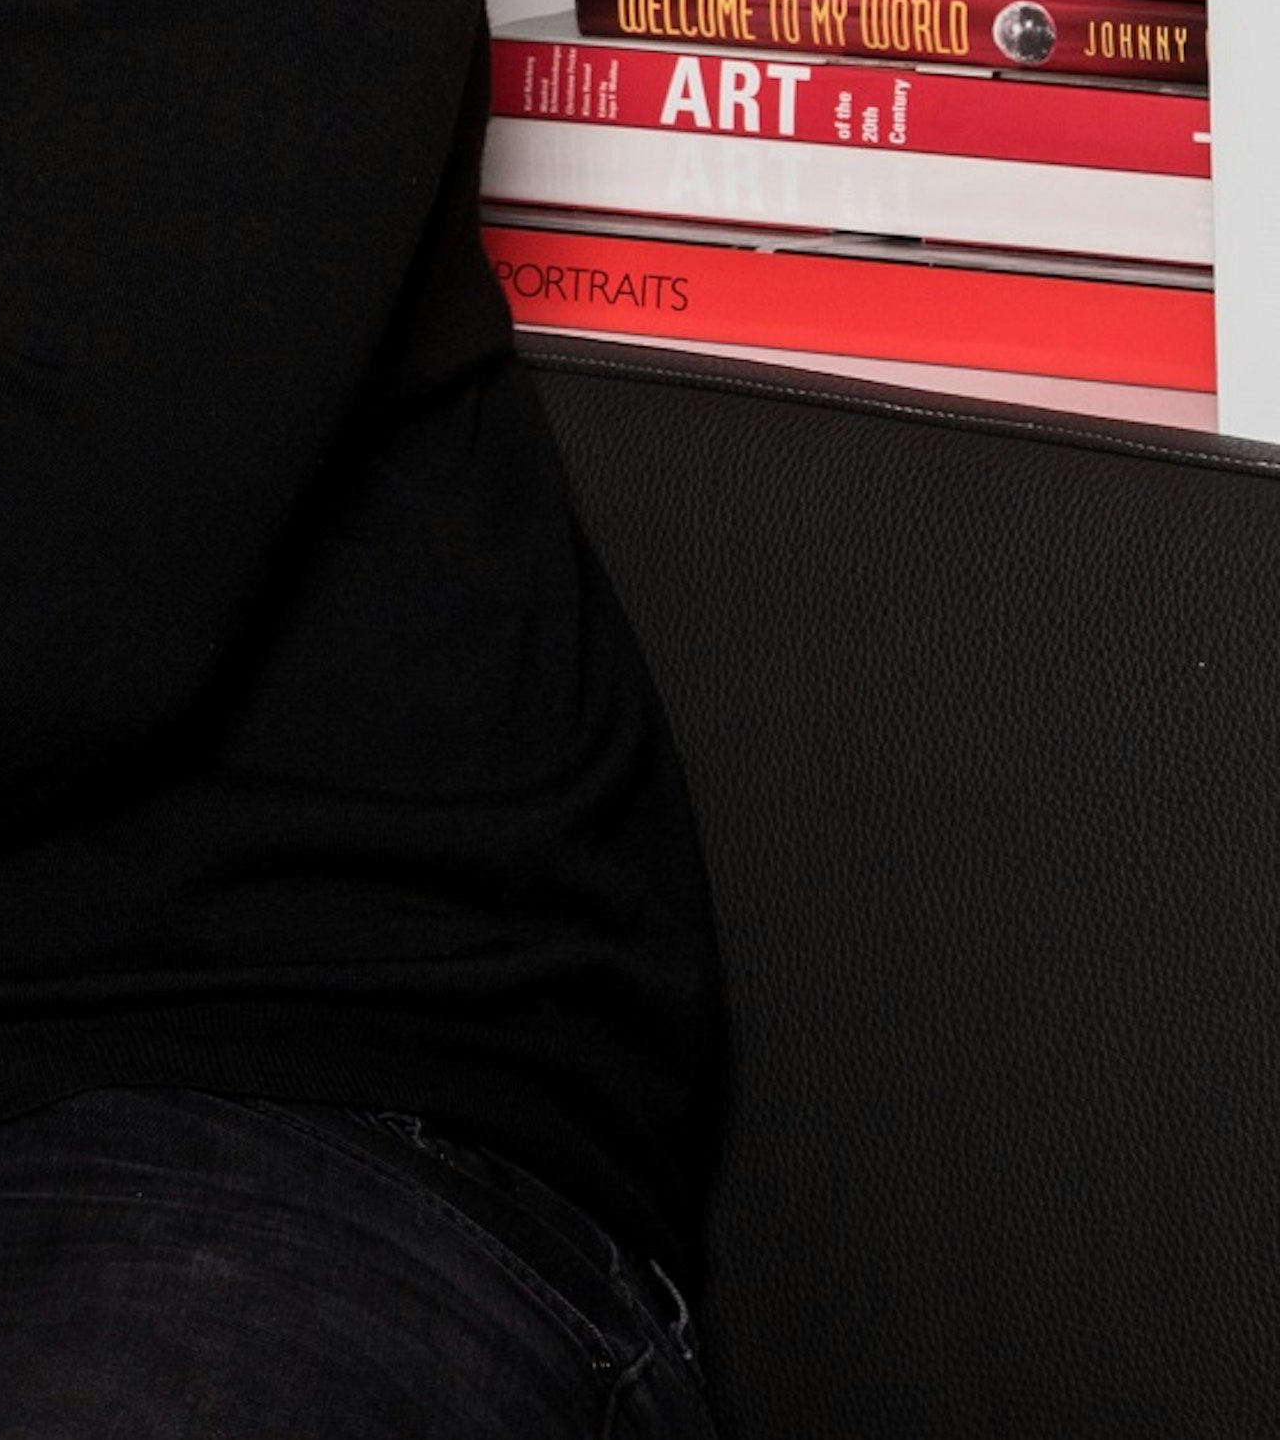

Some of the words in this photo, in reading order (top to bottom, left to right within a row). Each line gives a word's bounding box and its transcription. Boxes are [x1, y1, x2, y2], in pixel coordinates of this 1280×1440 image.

[1085, 21, 1187, 63] JOHNNY
[659, 55, 811, 137] ART
[889, 78, 912, 145] Century
